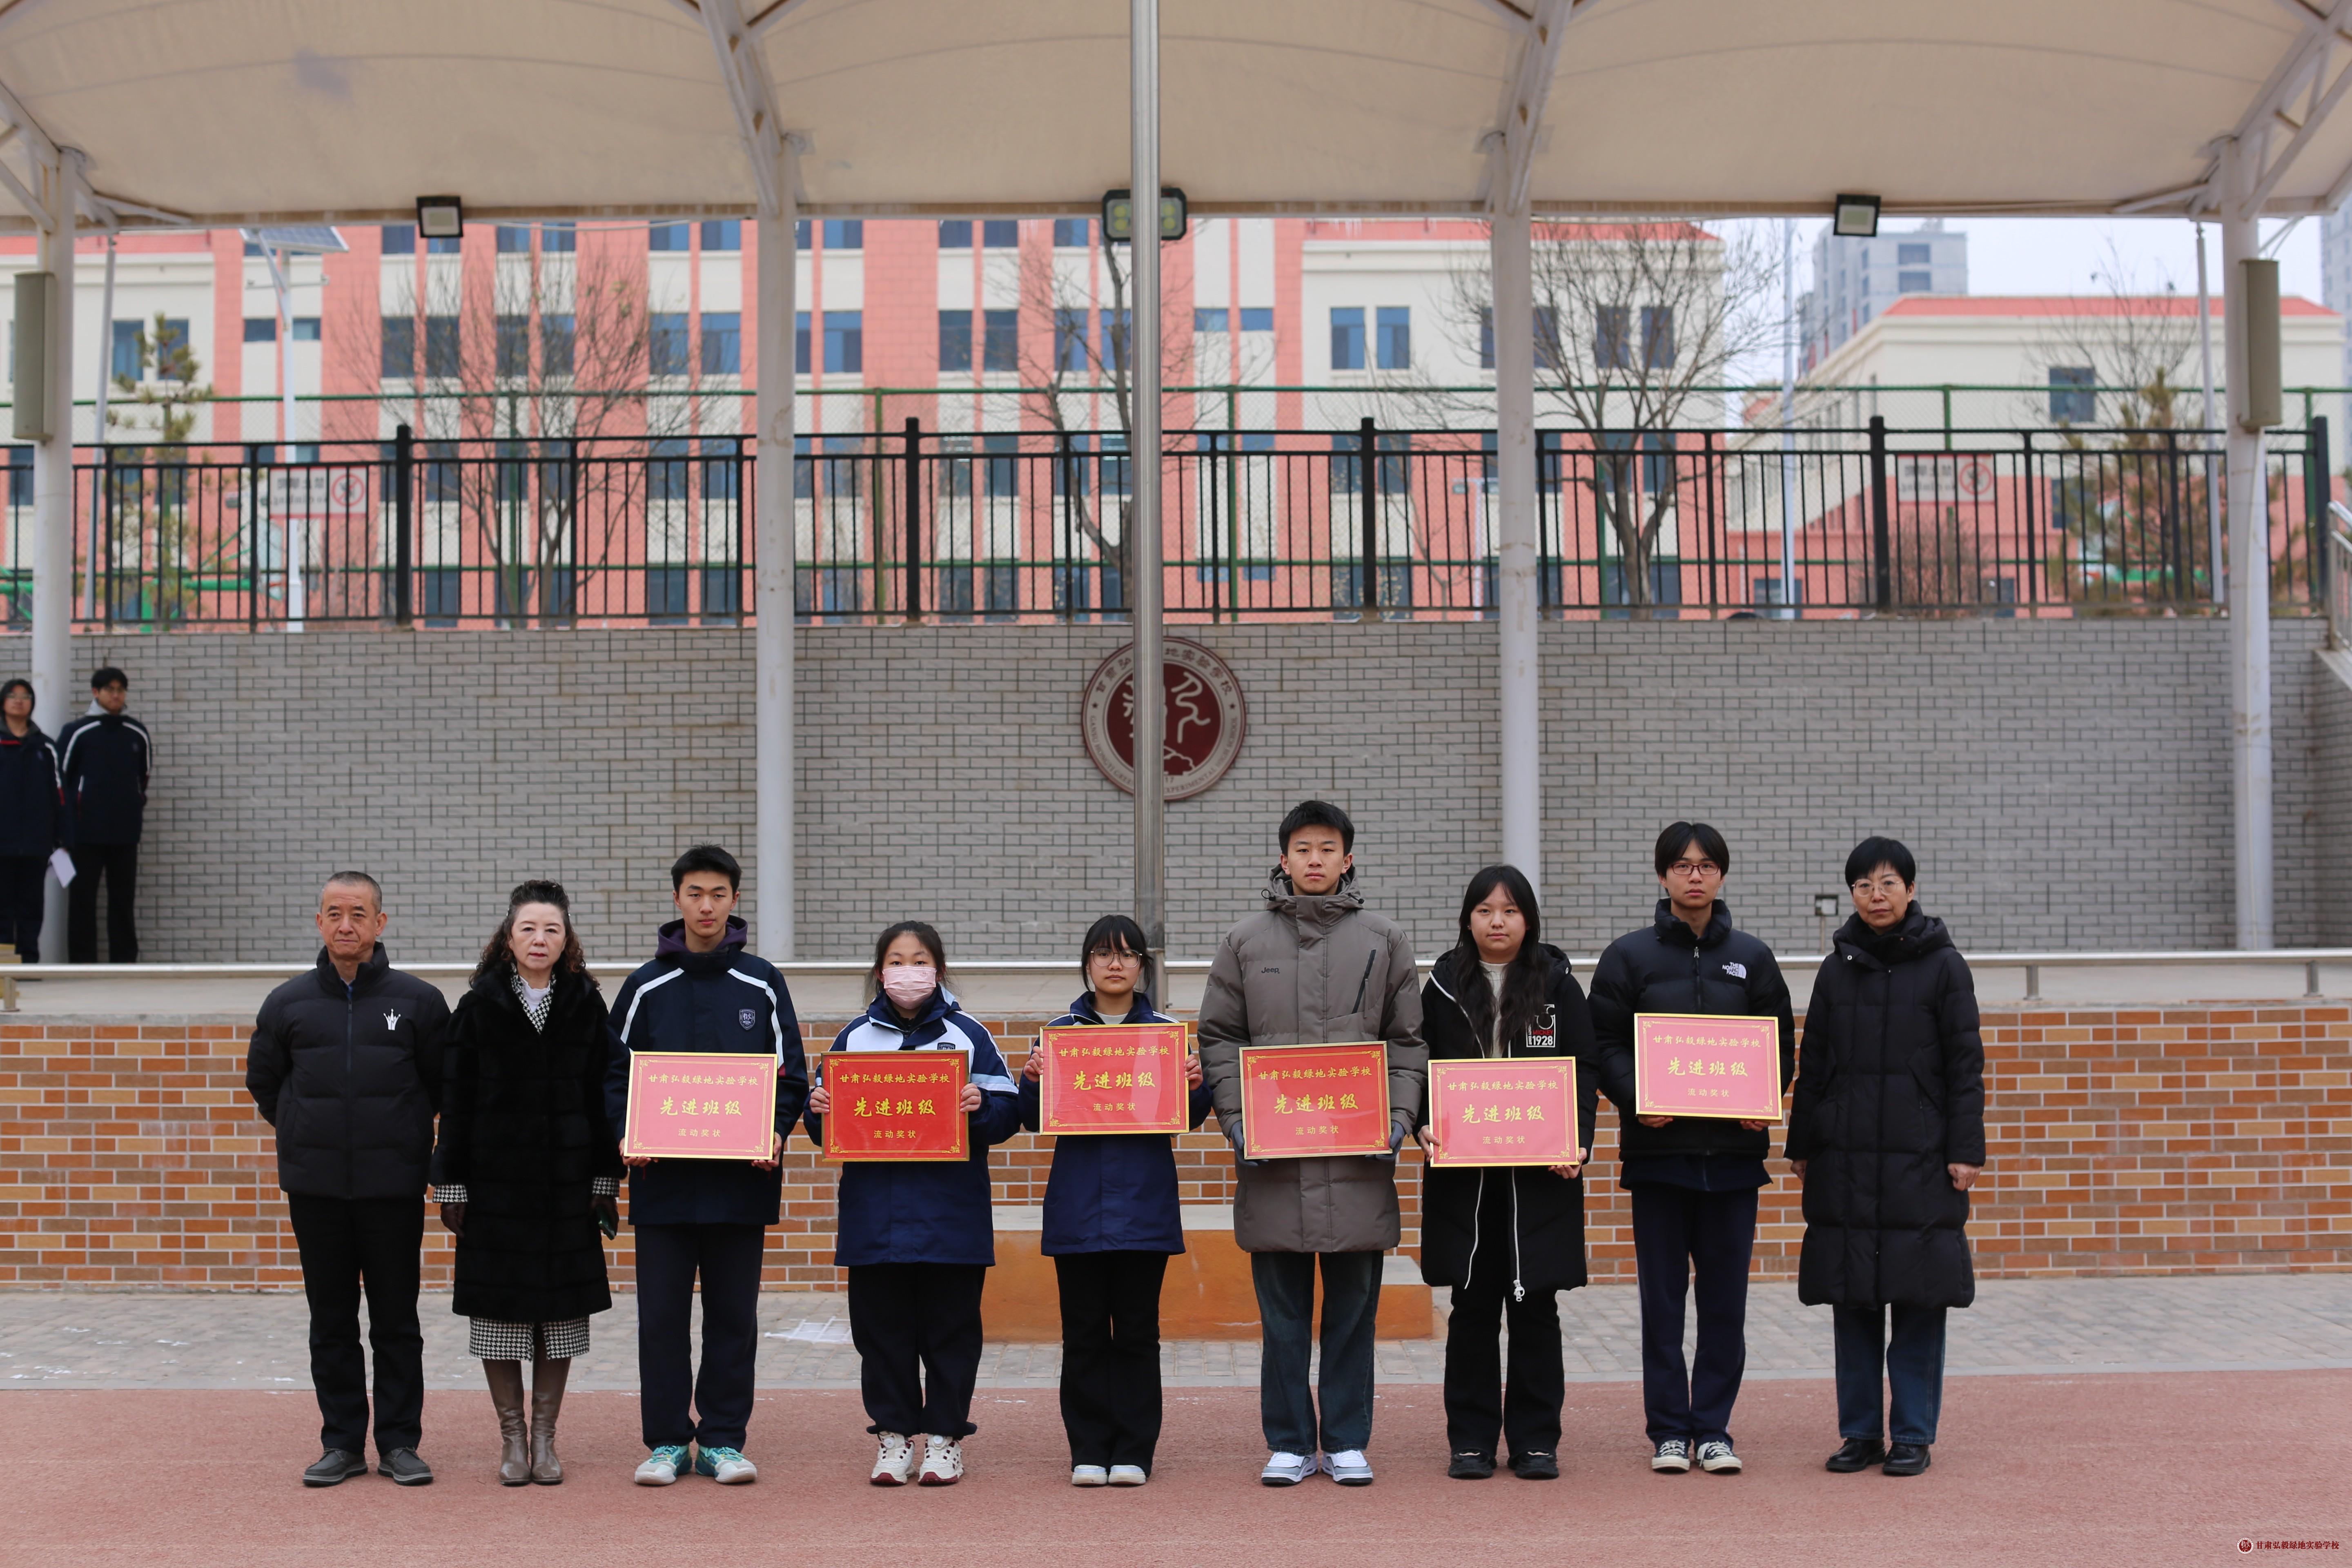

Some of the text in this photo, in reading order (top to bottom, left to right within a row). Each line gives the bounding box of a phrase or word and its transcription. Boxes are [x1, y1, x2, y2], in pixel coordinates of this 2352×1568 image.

[1532, 1035, 1553, 1046] 1928
[1653, 1034, 1761, 1048] 甘肃弘毅绿地实验学校
[1059, 1045, 1169, 1057] 甘肃弘毅绿地实验学校
[1668, 1057, 1748, 1076] 先进班级
[840, 1073, 950, 1084] 甘肃弘毅绿地实验学校
[1258, 1066, 1372, 1080] 甘肃弘毅绿地实验学校
[648, 1074, 758, 1086] 甘肃弘毅绿地实验学校
[1073, 1071, 1156, 1090] 先进班级
[1447, 1080, 1558, 1091] 甘肃弘毅绿地实验学校
[1688, 1088, 1729, 1097] 流动奖状
[660, 1096, 742, 1116] 先进班级
[853, 1097, 936, 1117] 先进班级
[1093, 1102, 1136, 1111] 流动奖状
[1274, 1094, 1358, 1114] 先进班级
[1462, 1104, 1544, 1123] 先进班级
[678, 1128, 721, 1137] 流动奖状
[874, 1130, 916, 1138] 流动奖状
[1296, 1125, 1339, 1135] 流动奖状
[1483, 1136, 1525, 1144] 流动奖状
